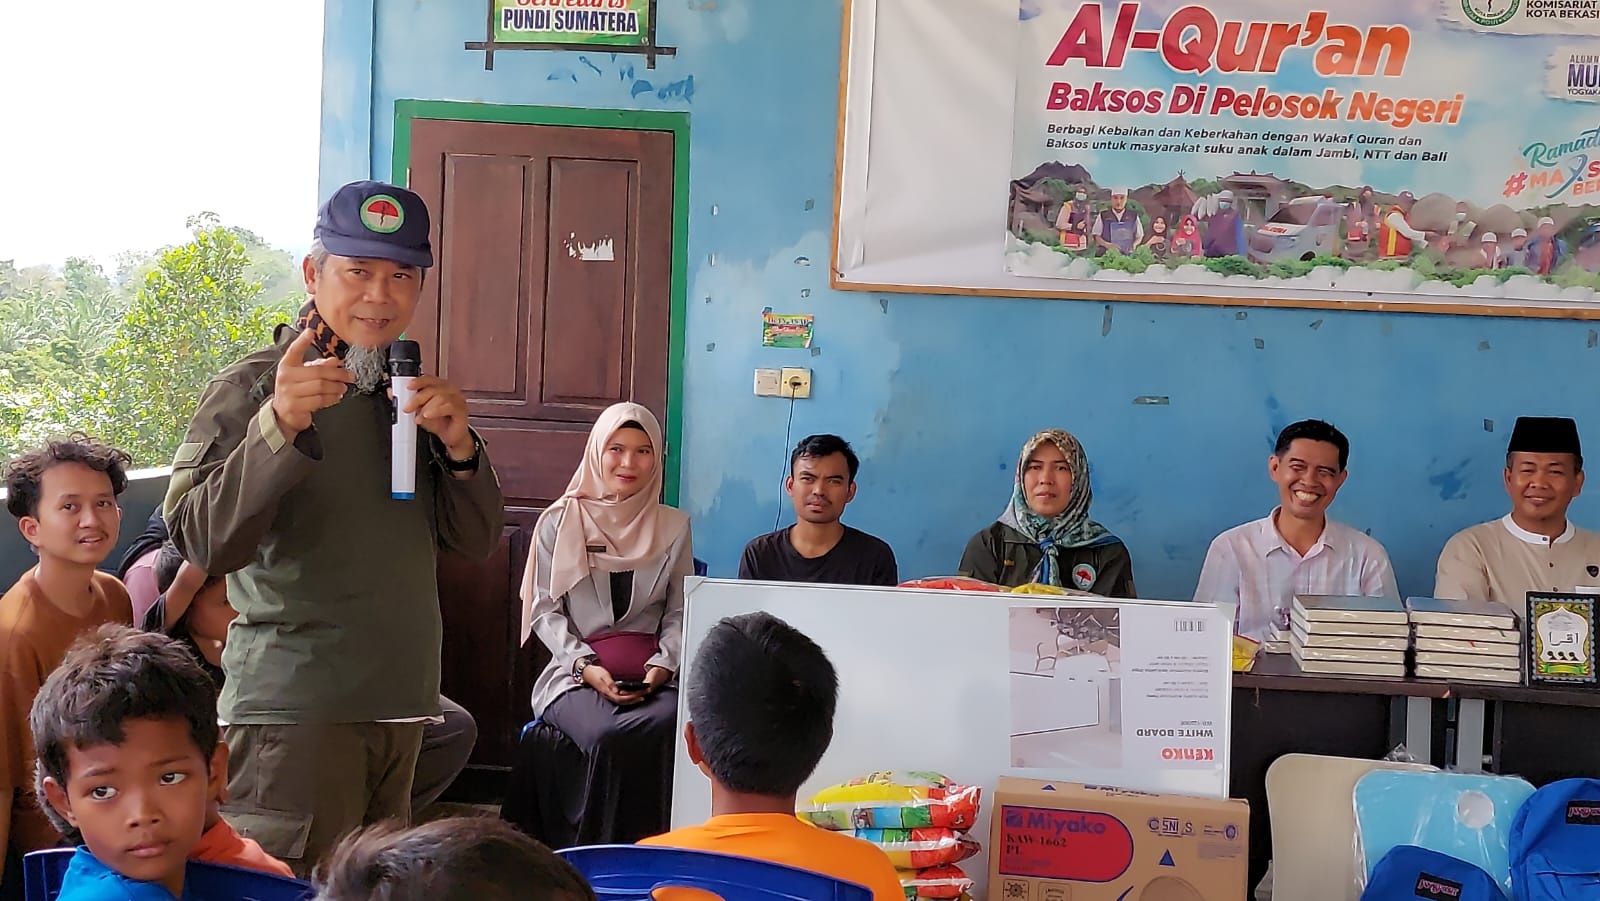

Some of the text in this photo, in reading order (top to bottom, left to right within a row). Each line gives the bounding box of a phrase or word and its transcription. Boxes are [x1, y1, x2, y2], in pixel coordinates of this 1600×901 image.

[1526, 0, 1598, 9] KOMISARIAT
[1526, 9, 1557, 18] KOTA
[1559, 9, 1600, 19] BEKASI
[503, 8, 638, 33] PUNDI SUMATERA
[1567, 63, 1600, 88] MU
[1046, 82, 1465, 128] Baksos Di Pelosok Negeri
[1047, 123, 1422, 146] Berbagi Kebaikan dan Keberkahan dengan Wakaf Quran dan
[1046, 138, 1448, 162] Baksos untuk masyarakat suku anak dalam Jambi, NTT dan Bali
[1136, 728, 1214, 738] WHITE BOARD
[1027, 811, 1107, 835] Miyako
[1162, 820, 1179, 832] SNI
